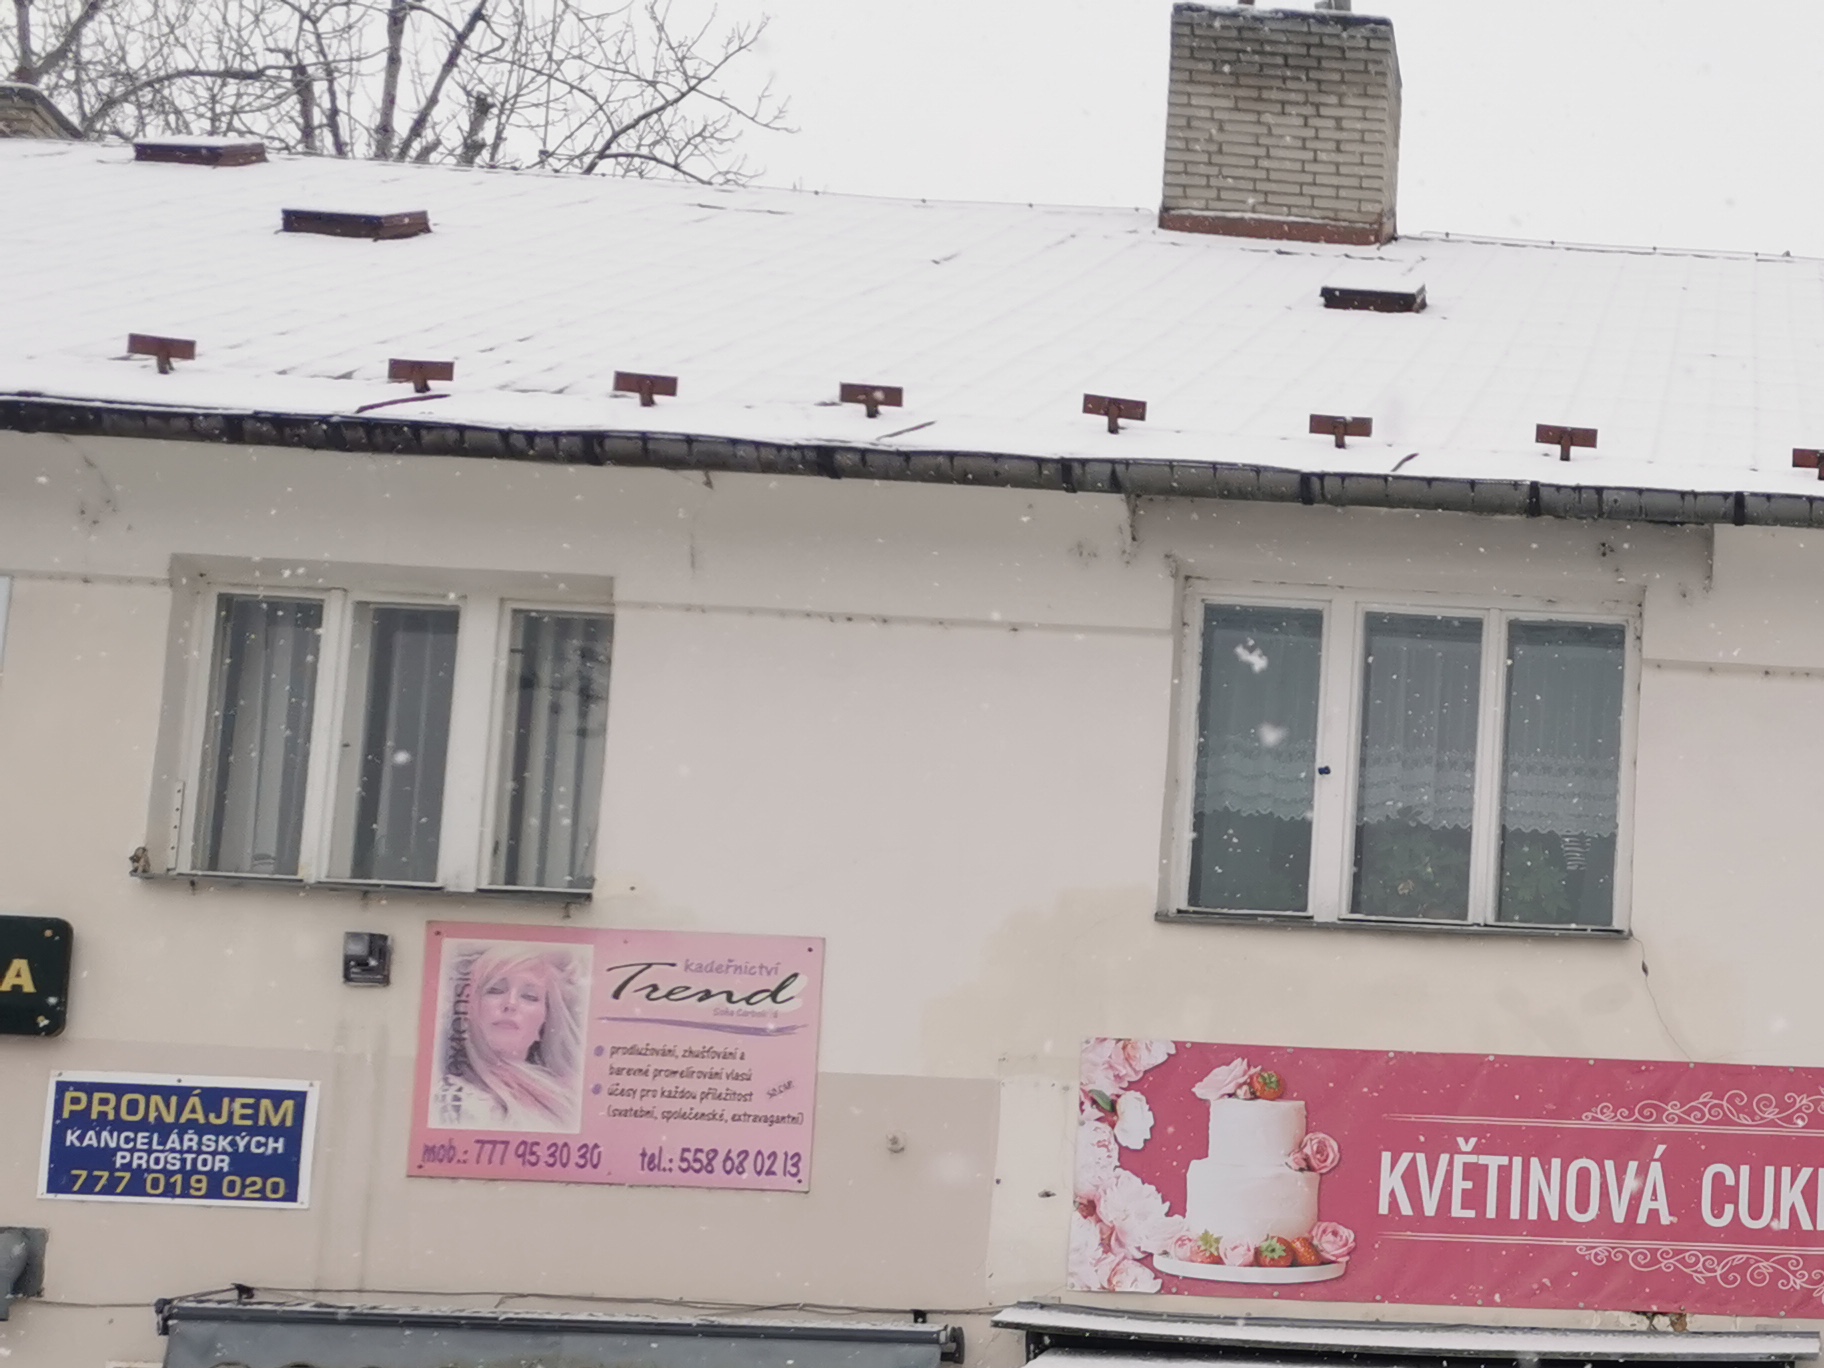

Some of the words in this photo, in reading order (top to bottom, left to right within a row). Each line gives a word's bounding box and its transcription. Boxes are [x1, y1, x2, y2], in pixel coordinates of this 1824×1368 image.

[684, 958, 782, 977] kadeřnictví
[606, 961, 800, 1006] Trend
[608, 1063, 650, 1078] barevné
[607, 1082, 637, 1100] účesy
[639, 1088, 658, 1101] pro
[660, 1086, 698, 1101] každou
[699, 1087, 755, 1104] příležitost
[61, 1089, 296, 1128] PRONÁJEM
[65, 1128, 285, 1155] KANCELÁŘSKÝCH
[473, 1139, 511, 1166] 777
[514, 1139, 541, 1168] 95
[544, 1141, 571, 1169] 30
[574, 1142, 602, 1170] 30
[114, 1150, 231, 1173] PROSTOR
[640, 1145, 674, 1173] tel.:
[677, 1147, 719, 1175] 558
[753, 1149, 778, 1177] 02
[783, 1150, 802, 1178] 13
[69, 1169, 132, 1193] 777
[145, 1172, 208, 1197] 019
[221, 1176, 286, 1199] 020
[1377, 1136, 1671, 1226] KVĚTINOVÁ
